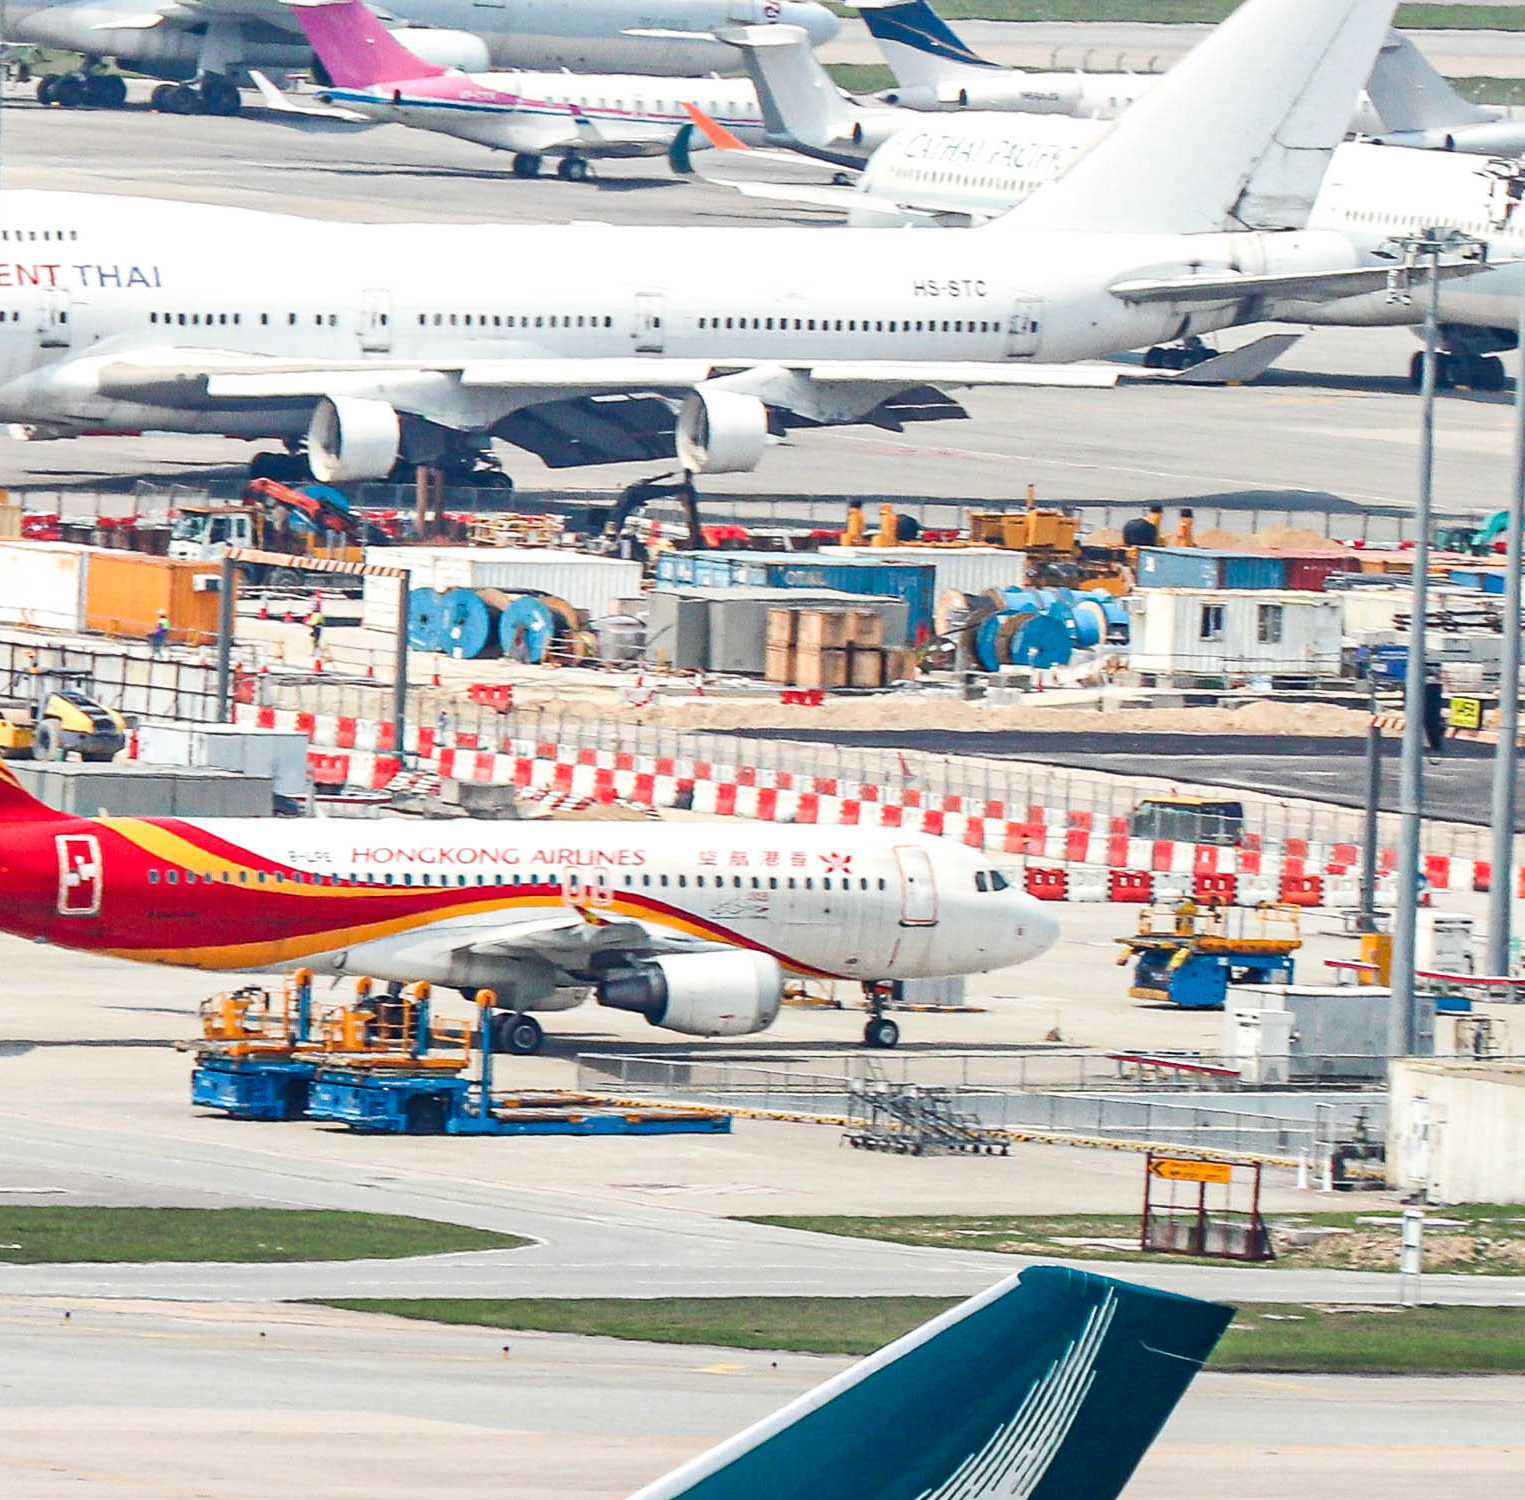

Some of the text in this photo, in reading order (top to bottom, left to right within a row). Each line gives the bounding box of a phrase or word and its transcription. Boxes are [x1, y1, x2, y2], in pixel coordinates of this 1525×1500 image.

[71, 264, 162, 288] THAI
[912, 279, 986, 297] HS-STC
[350, 847, 646, 866] HONGKONG AIRLINES
